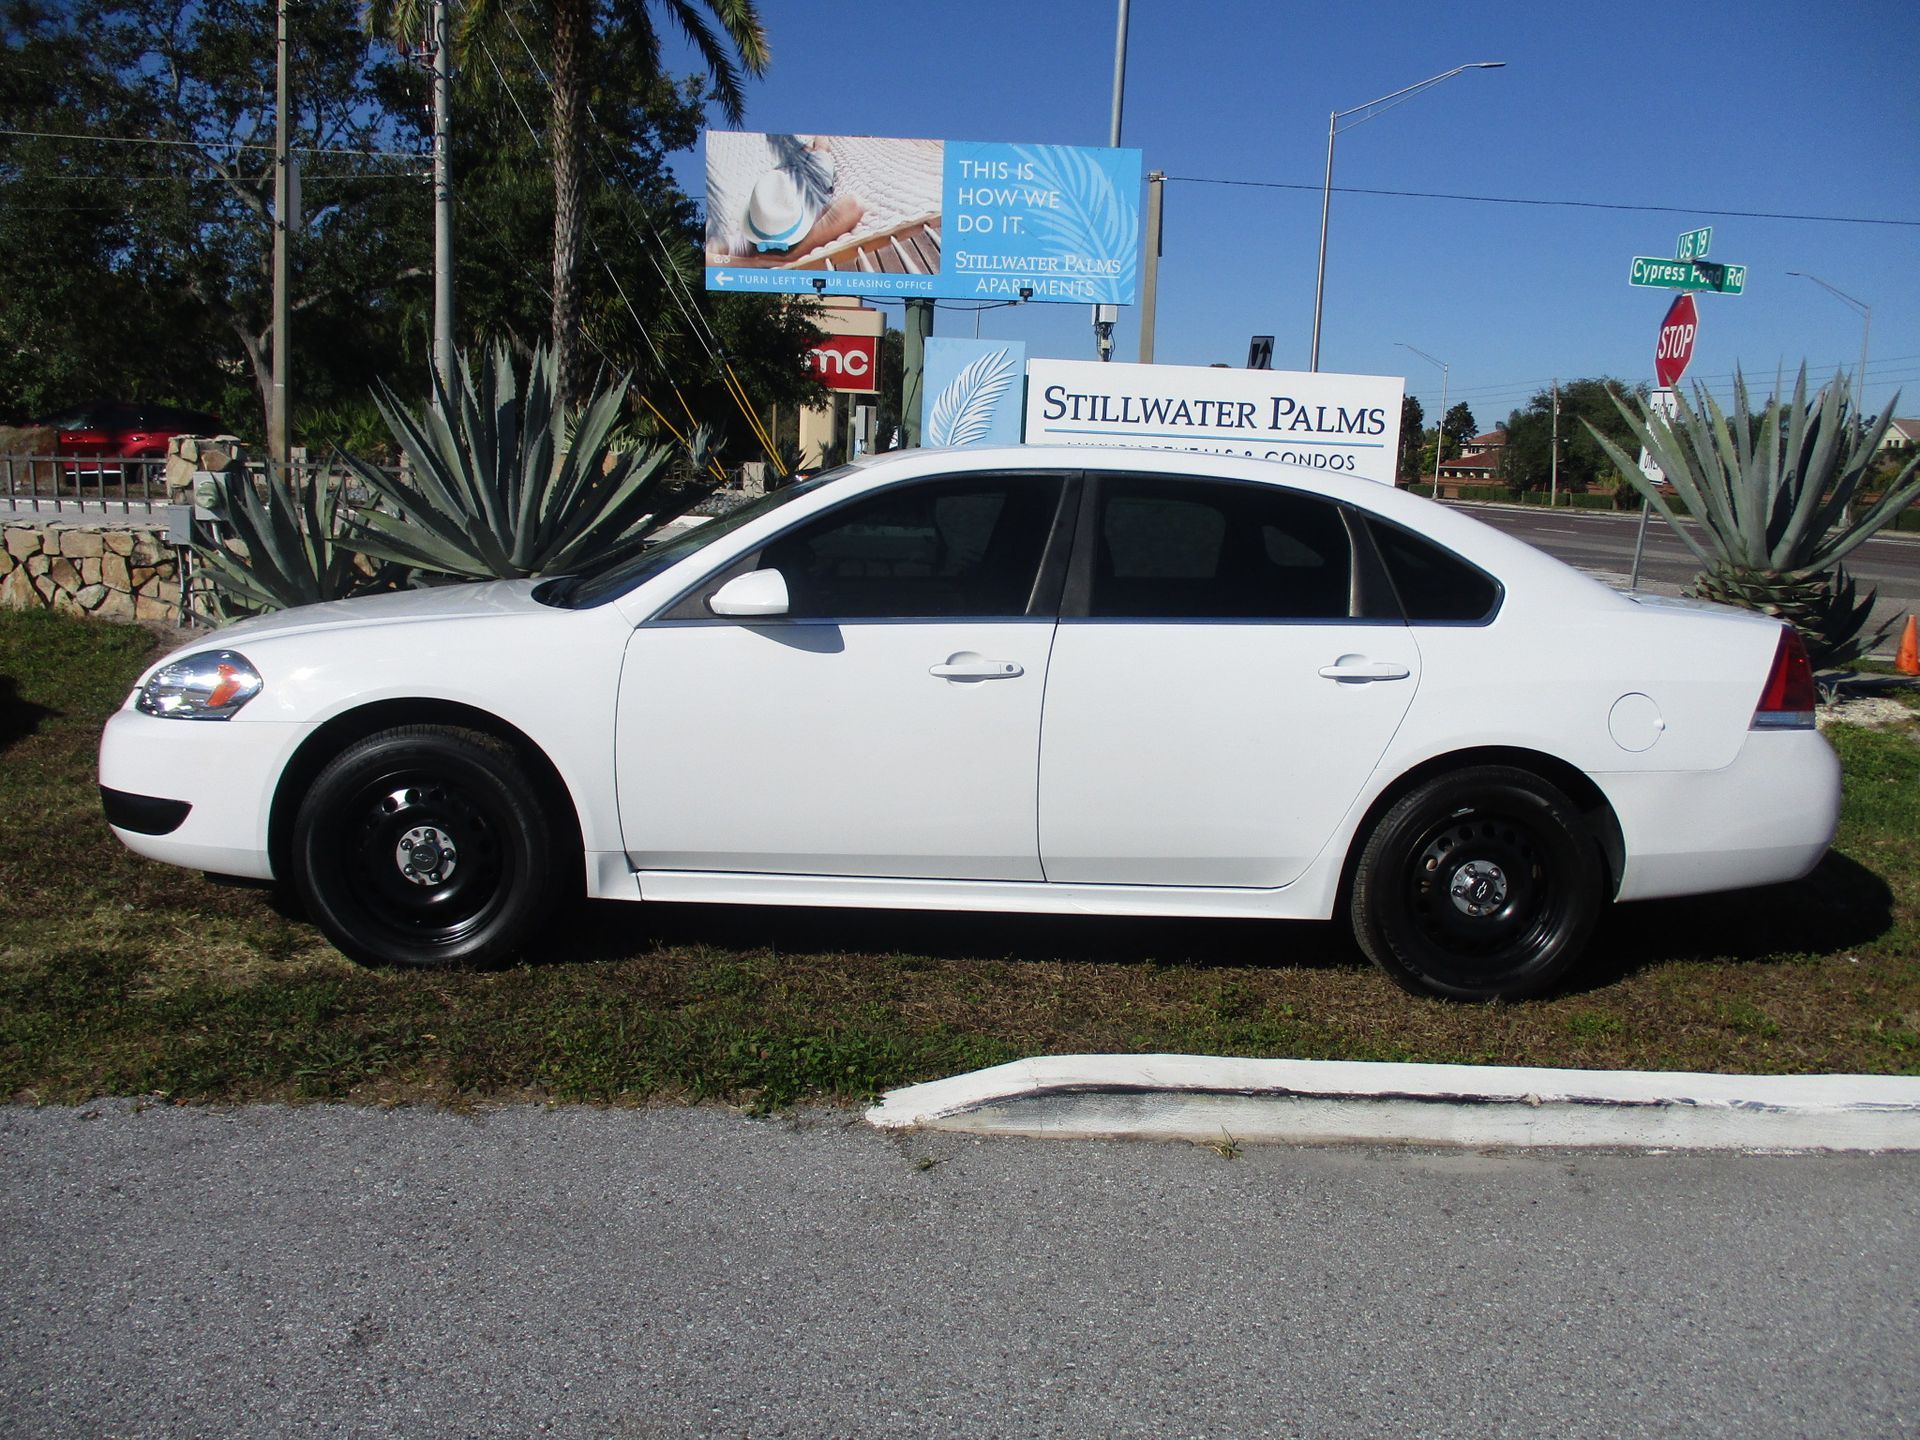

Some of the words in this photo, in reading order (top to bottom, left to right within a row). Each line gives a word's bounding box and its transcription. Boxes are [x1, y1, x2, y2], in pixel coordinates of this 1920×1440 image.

[959, 160, 1008, 180] THIS
[1017, 162, 1034, 181] IS
[958, 187, 1018, 206] HOW
[1023, 190, 1060, 209] WE
[957, 214, 993, 233] DO
[1002, 215, 1025, 235] IT.
[1679, 234, 1694, 259] US
[1695, 230, 1708, 256] 19
[955, 250, 1058, 271] STILLWATER
[1063, 254, 1121, 274] PALMS
[1633, 259, 1686, 284] Cypress
[1726, 267, 1744, 287] Rd
[738, 275, 768, 284] TURN
[772, 276, 796, 286] LEFT
[847, 279, 891, 289] LEASING
[895, 280, 933, 290] OFFICE
[975, 277, 1095, 297] APARTMENTS
[1658, 324, 1694, 360] STOP
[1043, 385, 1257, 429] STILLWATER
[1268, 396, 1386, 435] PALMS
